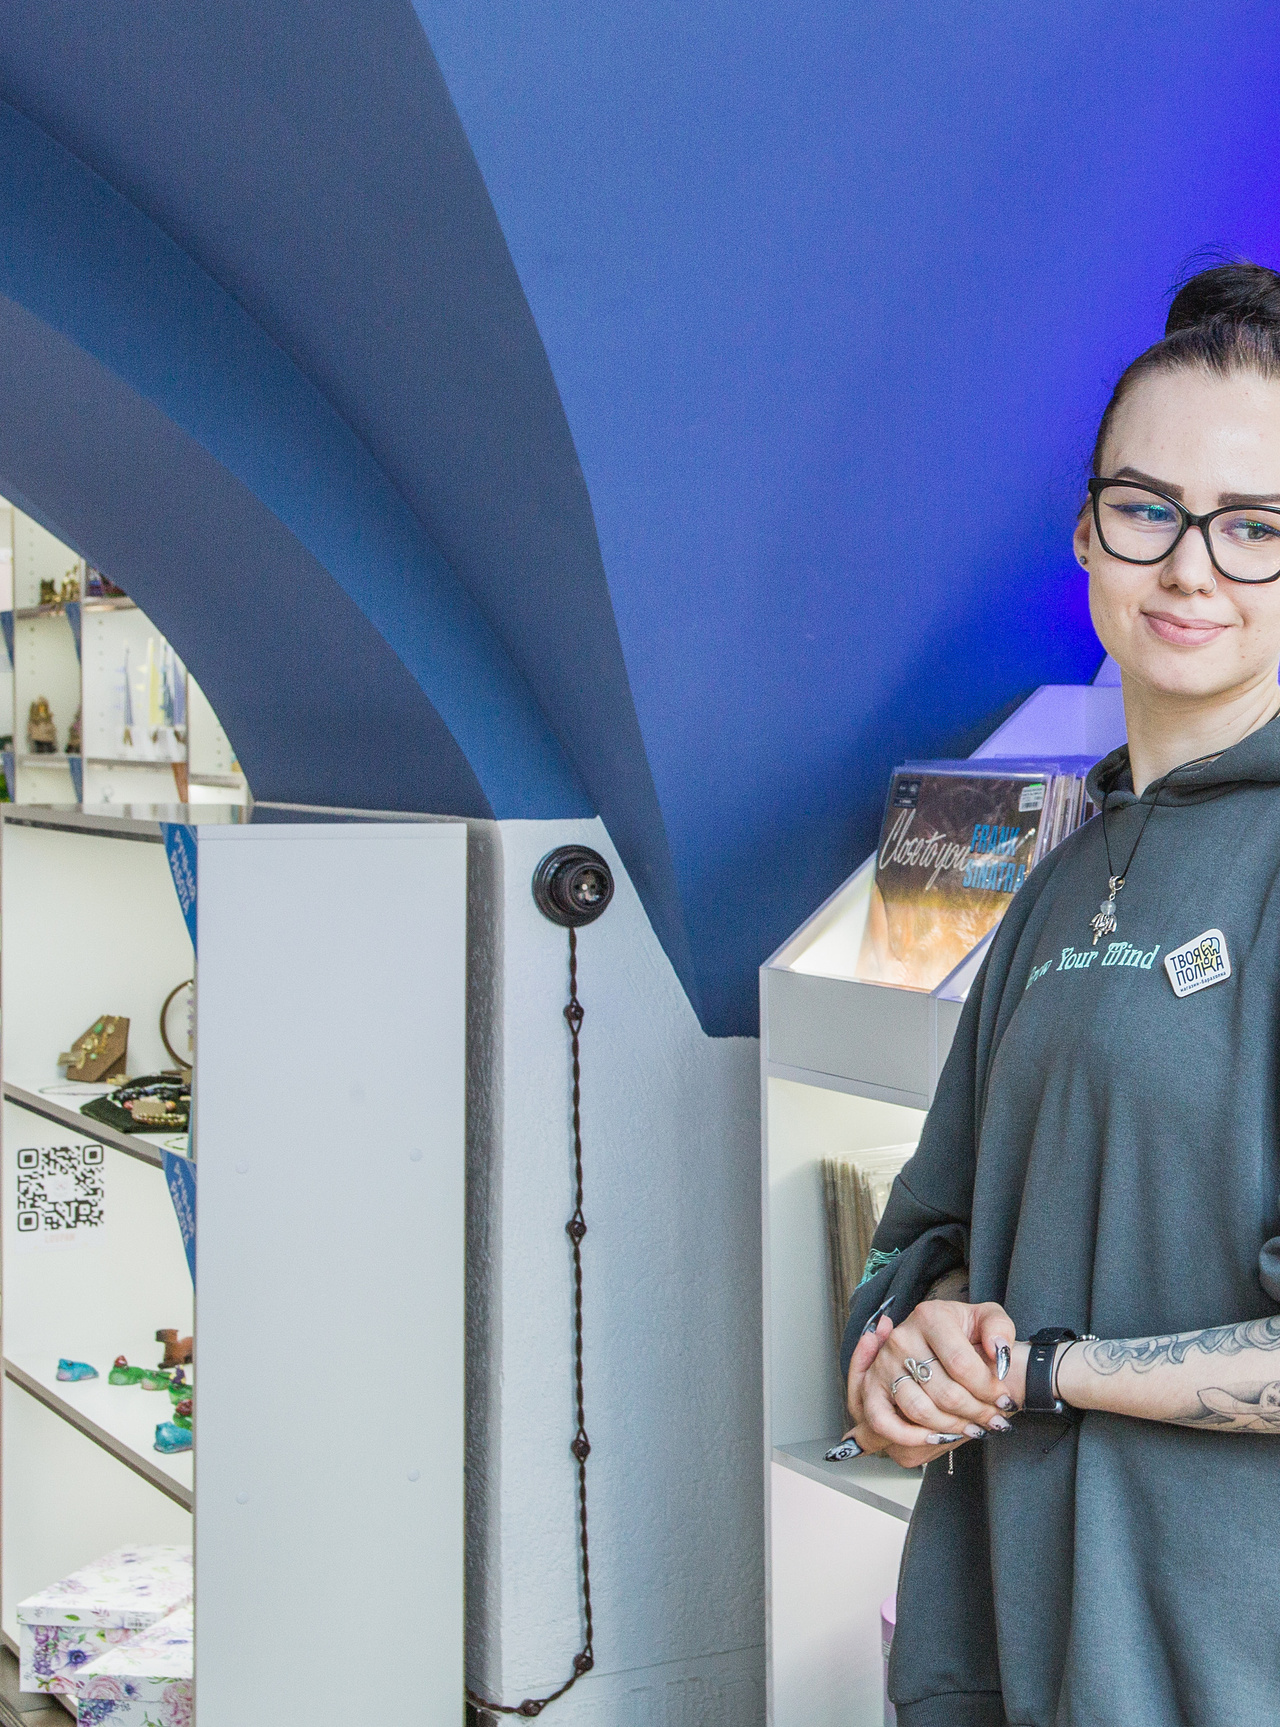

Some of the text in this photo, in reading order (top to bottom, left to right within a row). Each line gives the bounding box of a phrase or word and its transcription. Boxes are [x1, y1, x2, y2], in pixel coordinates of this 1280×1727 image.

[969, 823, 1021, 857] FRANK
[962, 858, 1026, 893] SINATRA
[1056, 946, 1099, 971] Your
[1101, 941, 1161, 970] Mind
[1169, 947, 1202, 971] ТВОЯ
